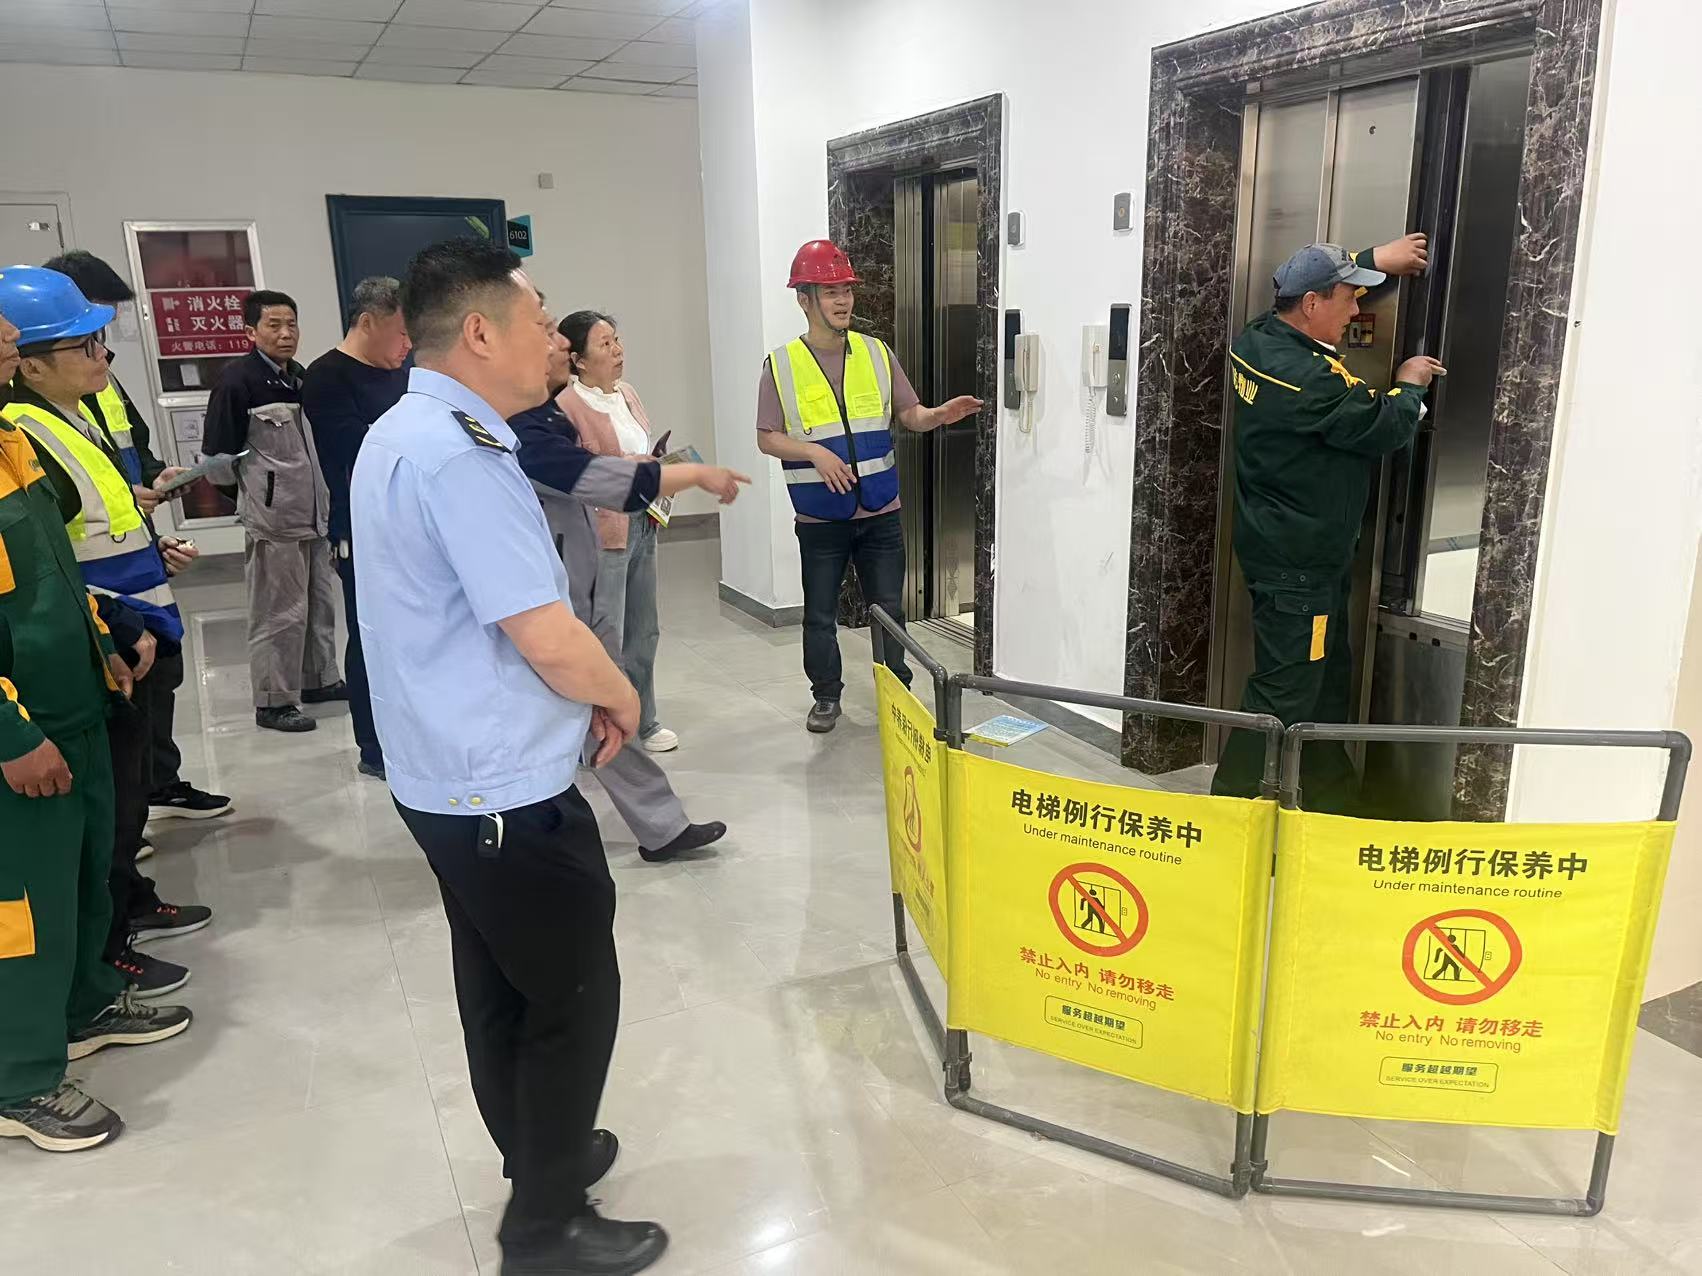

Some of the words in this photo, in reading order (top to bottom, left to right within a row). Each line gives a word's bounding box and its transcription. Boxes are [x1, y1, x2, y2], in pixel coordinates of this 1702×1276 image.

[509, 230, 528, 240] 6102
[187, 295, 241, 311] 消火栓
[190, 315, 244, 331] 灭火器
[1011, 788, 1202, 848] 电梯例行保养中
[1023, 823, 1058, 840] Under
[1060, 833, 1136, 857] maintenance
[1139, 849, 1182, 865] routine
[1358, 844, 1588, 881] 电梯例行保养中
[1373, 879, 1416, 891] Under
[1418, 882, 1510, 897] maintenance
[1513, 886, 1563, 898] routine
[1020, 946, 1089, 979] 禁止入内
[1099, 968, 1175, 1001] 请勿移走
[1035, 968, 1051, 980] No
[1054, 974, 1082, 991] entry
[1088, 982, 1103, 995] No
[1105, 988, 1157, 1011] removing
[1062, 1004, 1126, 1031] 服务超越期望
[1359, 1010, 1445, 1032] 禁止入内
[1456, 1017, 1544, 1038] 请勿移走
[1375, 1030, 1394, 1041] No
[1399, 1032, 1432, 1046] entry
[1440, 1035, 1458, 1046] No
[1461, 1037, 1521, 1053] removing
[1401, 1062, 1478, 1076] 服务超越期望
